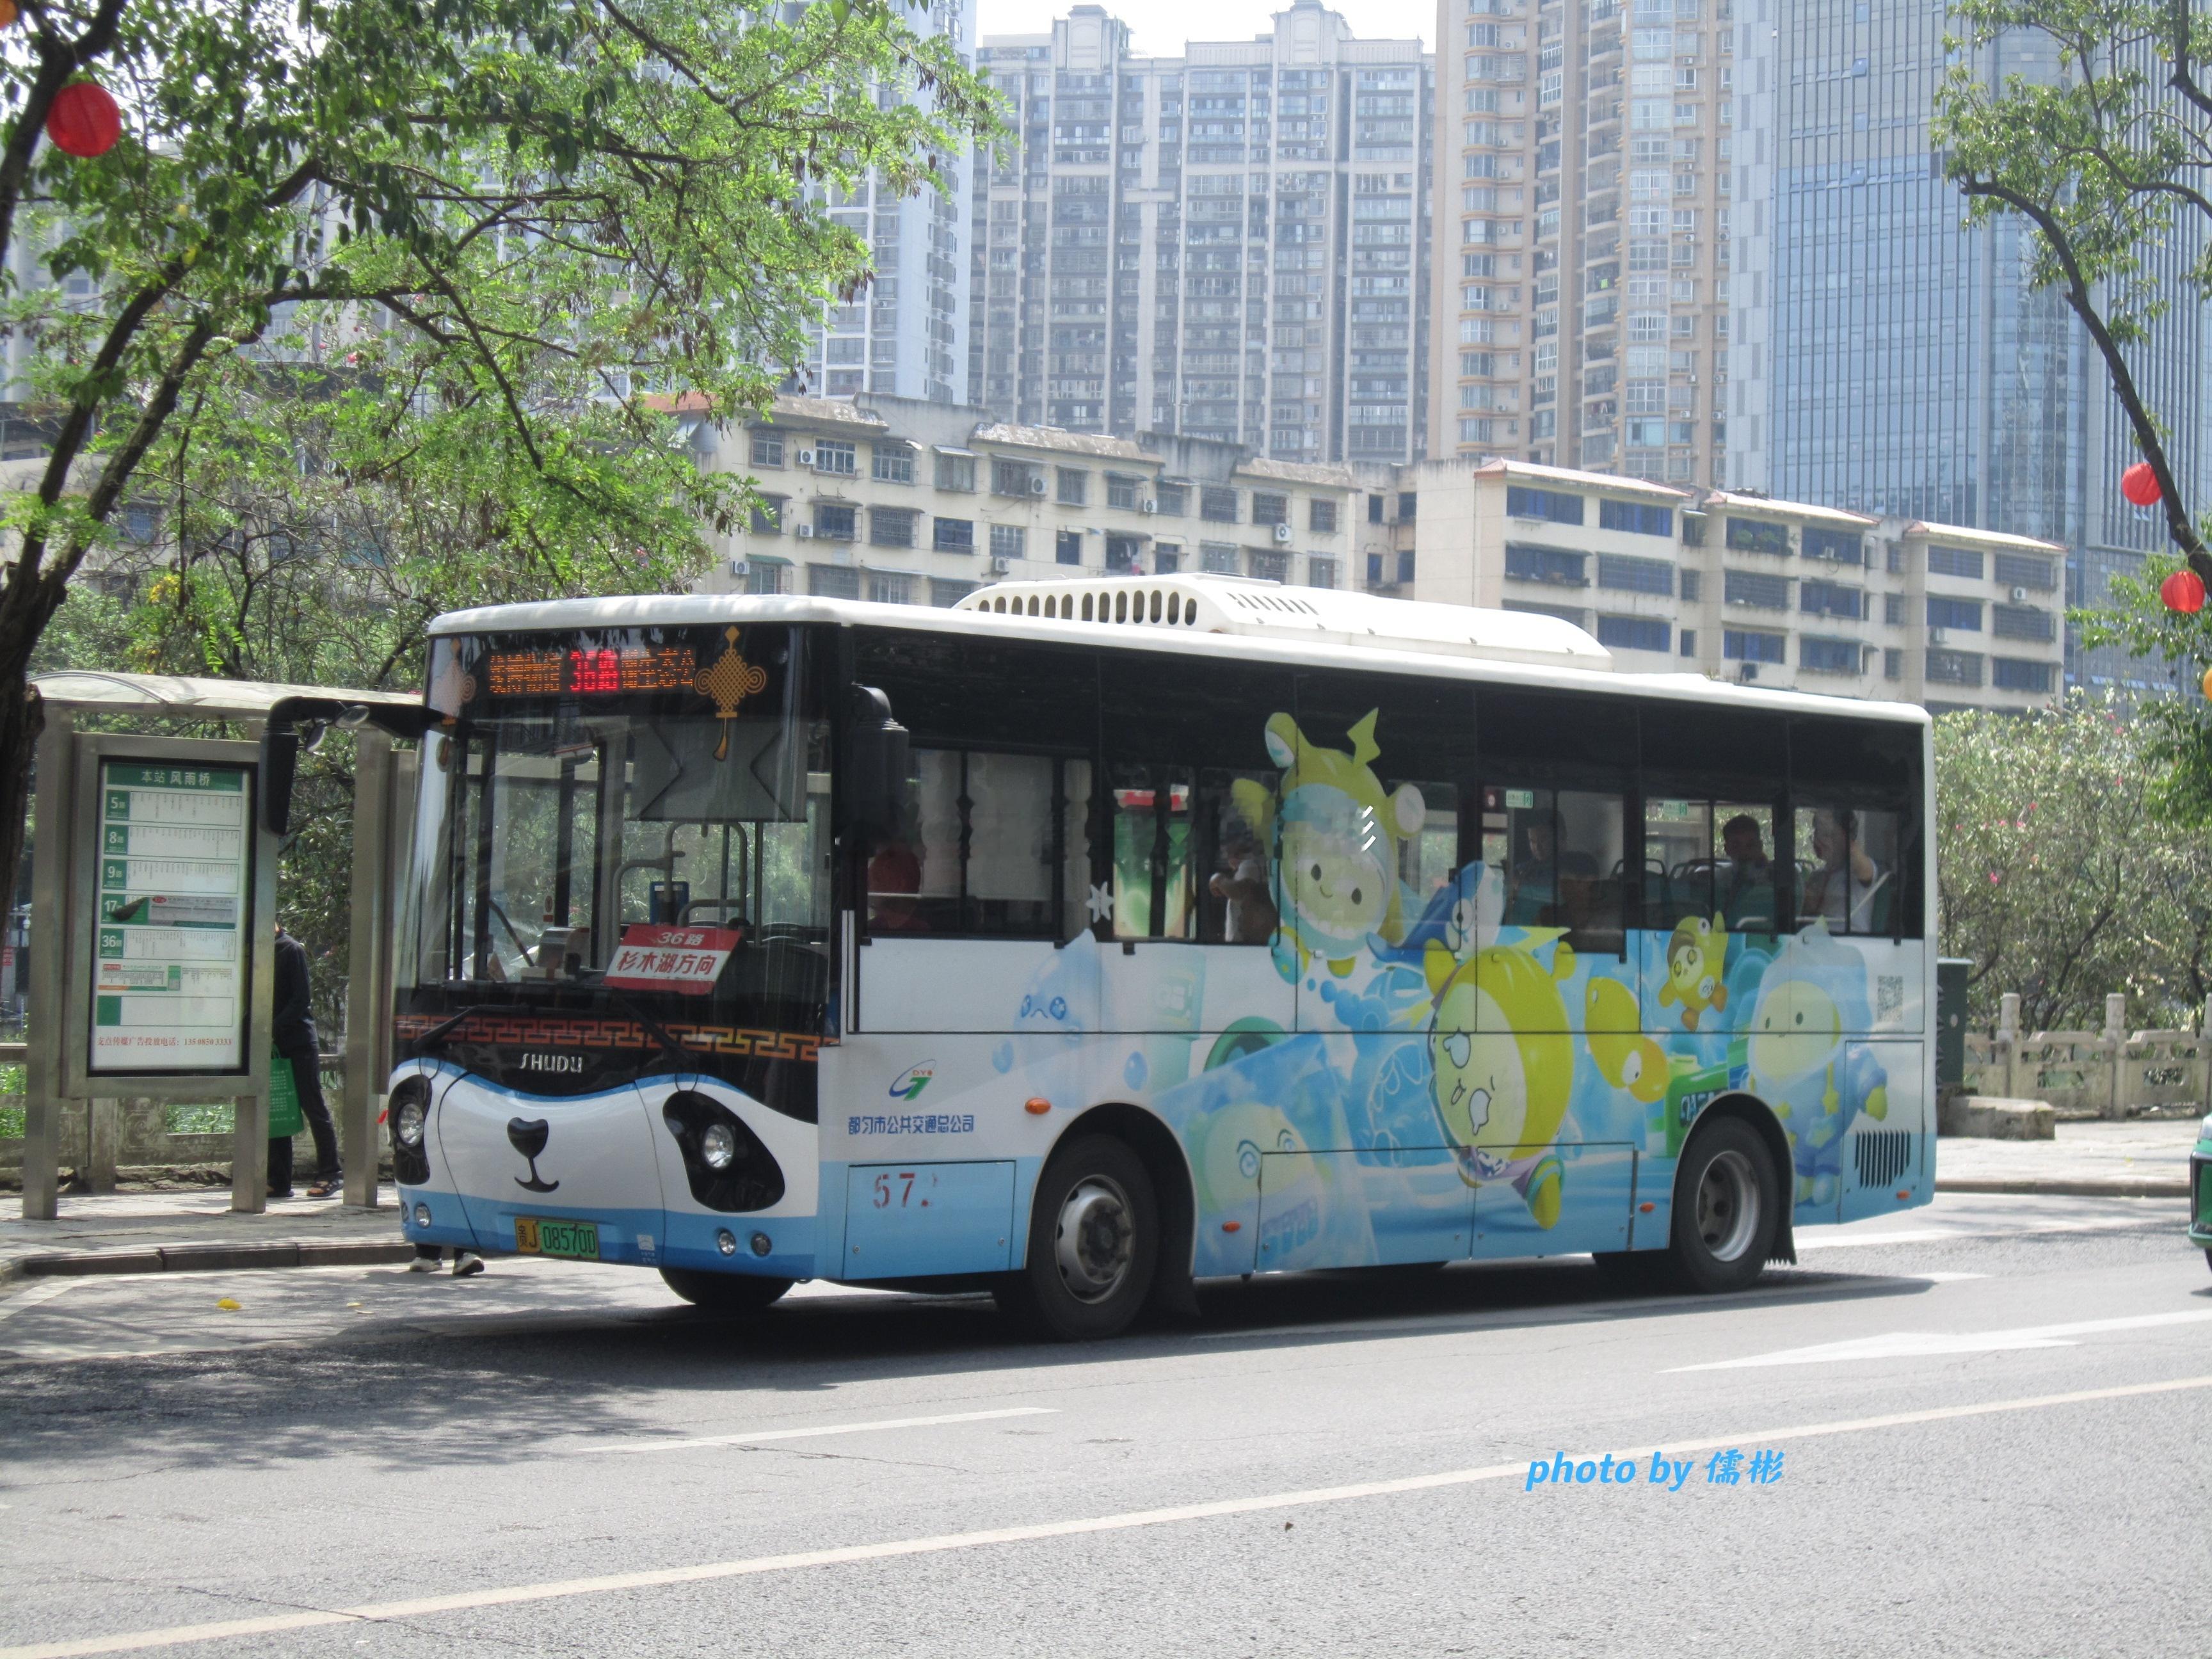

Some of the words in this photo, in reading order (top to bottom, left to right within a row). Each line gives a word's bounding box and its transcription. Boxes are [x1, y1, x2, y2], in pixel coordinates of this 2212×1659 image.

[141, 770, 164, 783] 本站
[170, 771, 211, 787] 风雨桥
[657, 932, 705, 945] 36路
[617, 950, 717, 975] 杉木湖方向
[519, 1053, 583, 1073] SHUDU
[848, 1115, 975, 1135] 都匀市公共交通总公司
